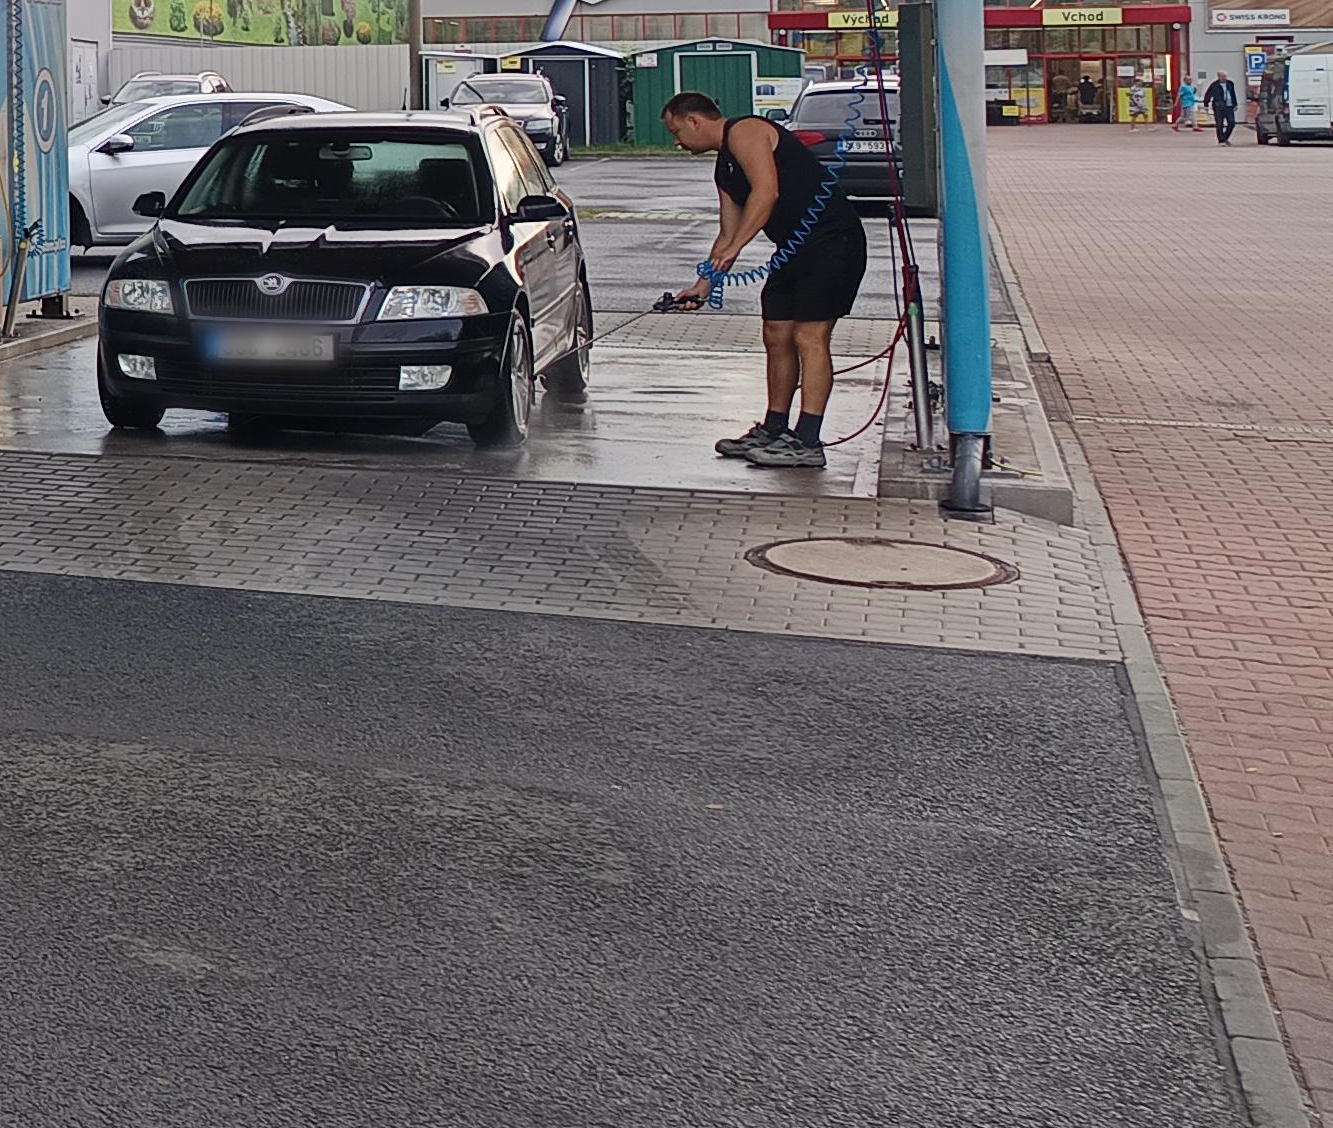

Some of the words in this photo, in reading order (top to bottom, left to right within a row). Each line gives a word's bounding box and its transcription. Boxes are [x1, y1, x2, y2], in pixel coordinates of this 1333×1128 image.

[1061, 10, 1104, 22] Vchod
[1251, 55, 1263, 69] P
[40, 89, 49, 132] 1
